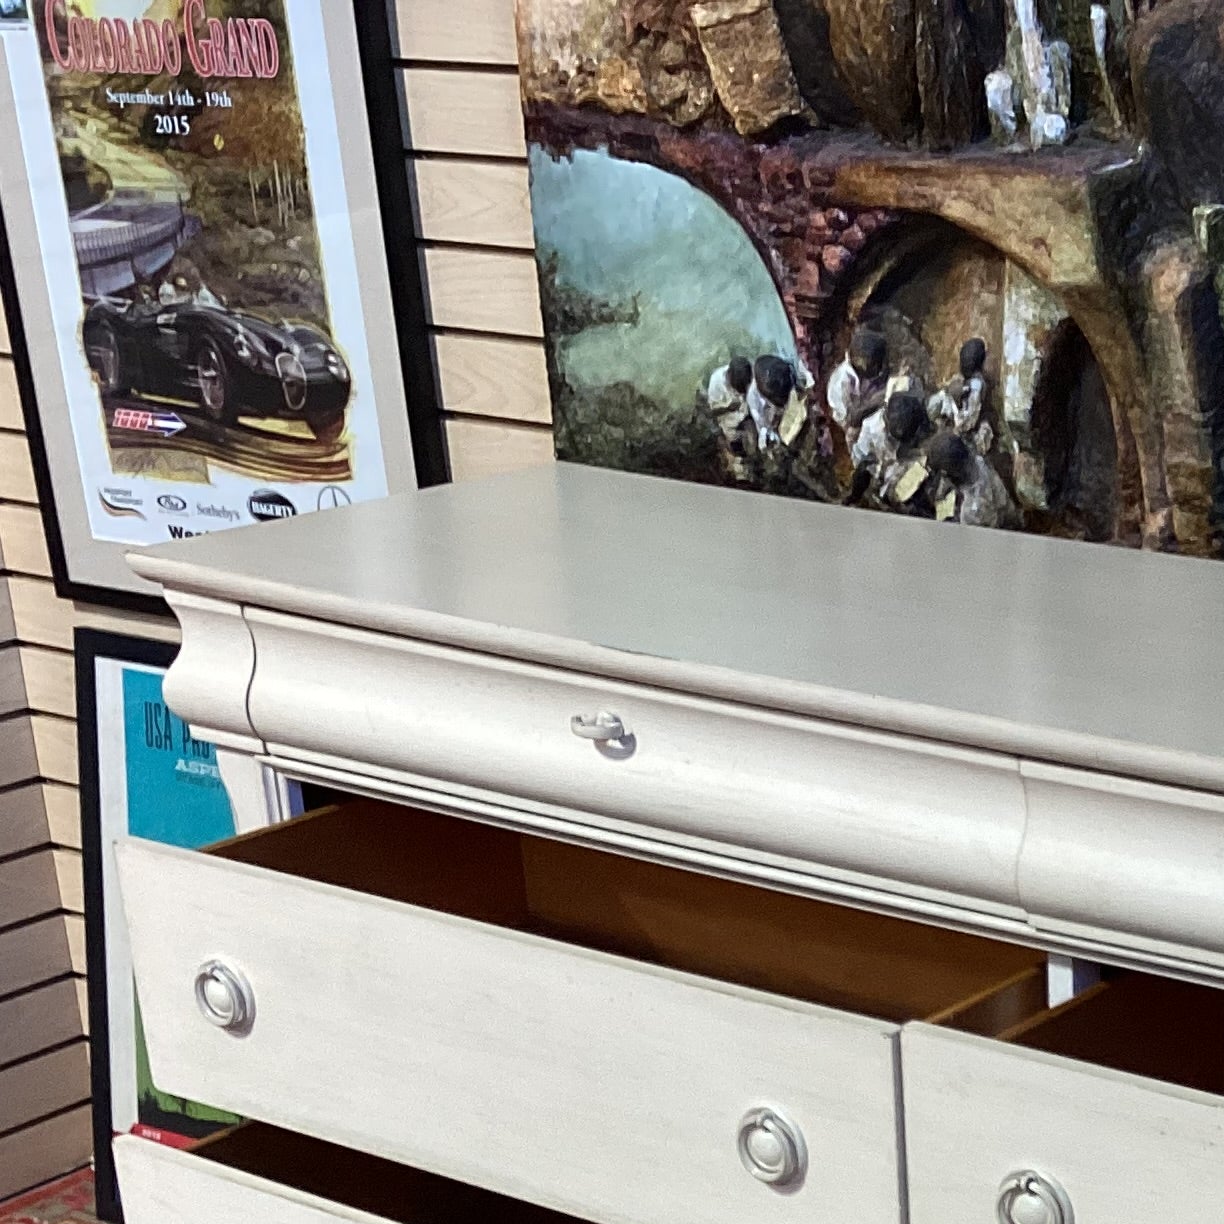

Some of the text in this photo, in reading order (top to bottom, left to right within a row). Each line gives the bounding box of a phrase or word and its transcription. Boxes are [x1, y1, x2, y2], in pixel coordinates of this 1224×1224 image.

[45, 0, 280, 79] COLORADO GRAND
[106, 87, 164, 109] September
[168, 89, 195, 107] 14th
[205, 90, 233, 108] 19th
[154, 114, 191, 136] 2015
[144, 701, 173, 752] USA
